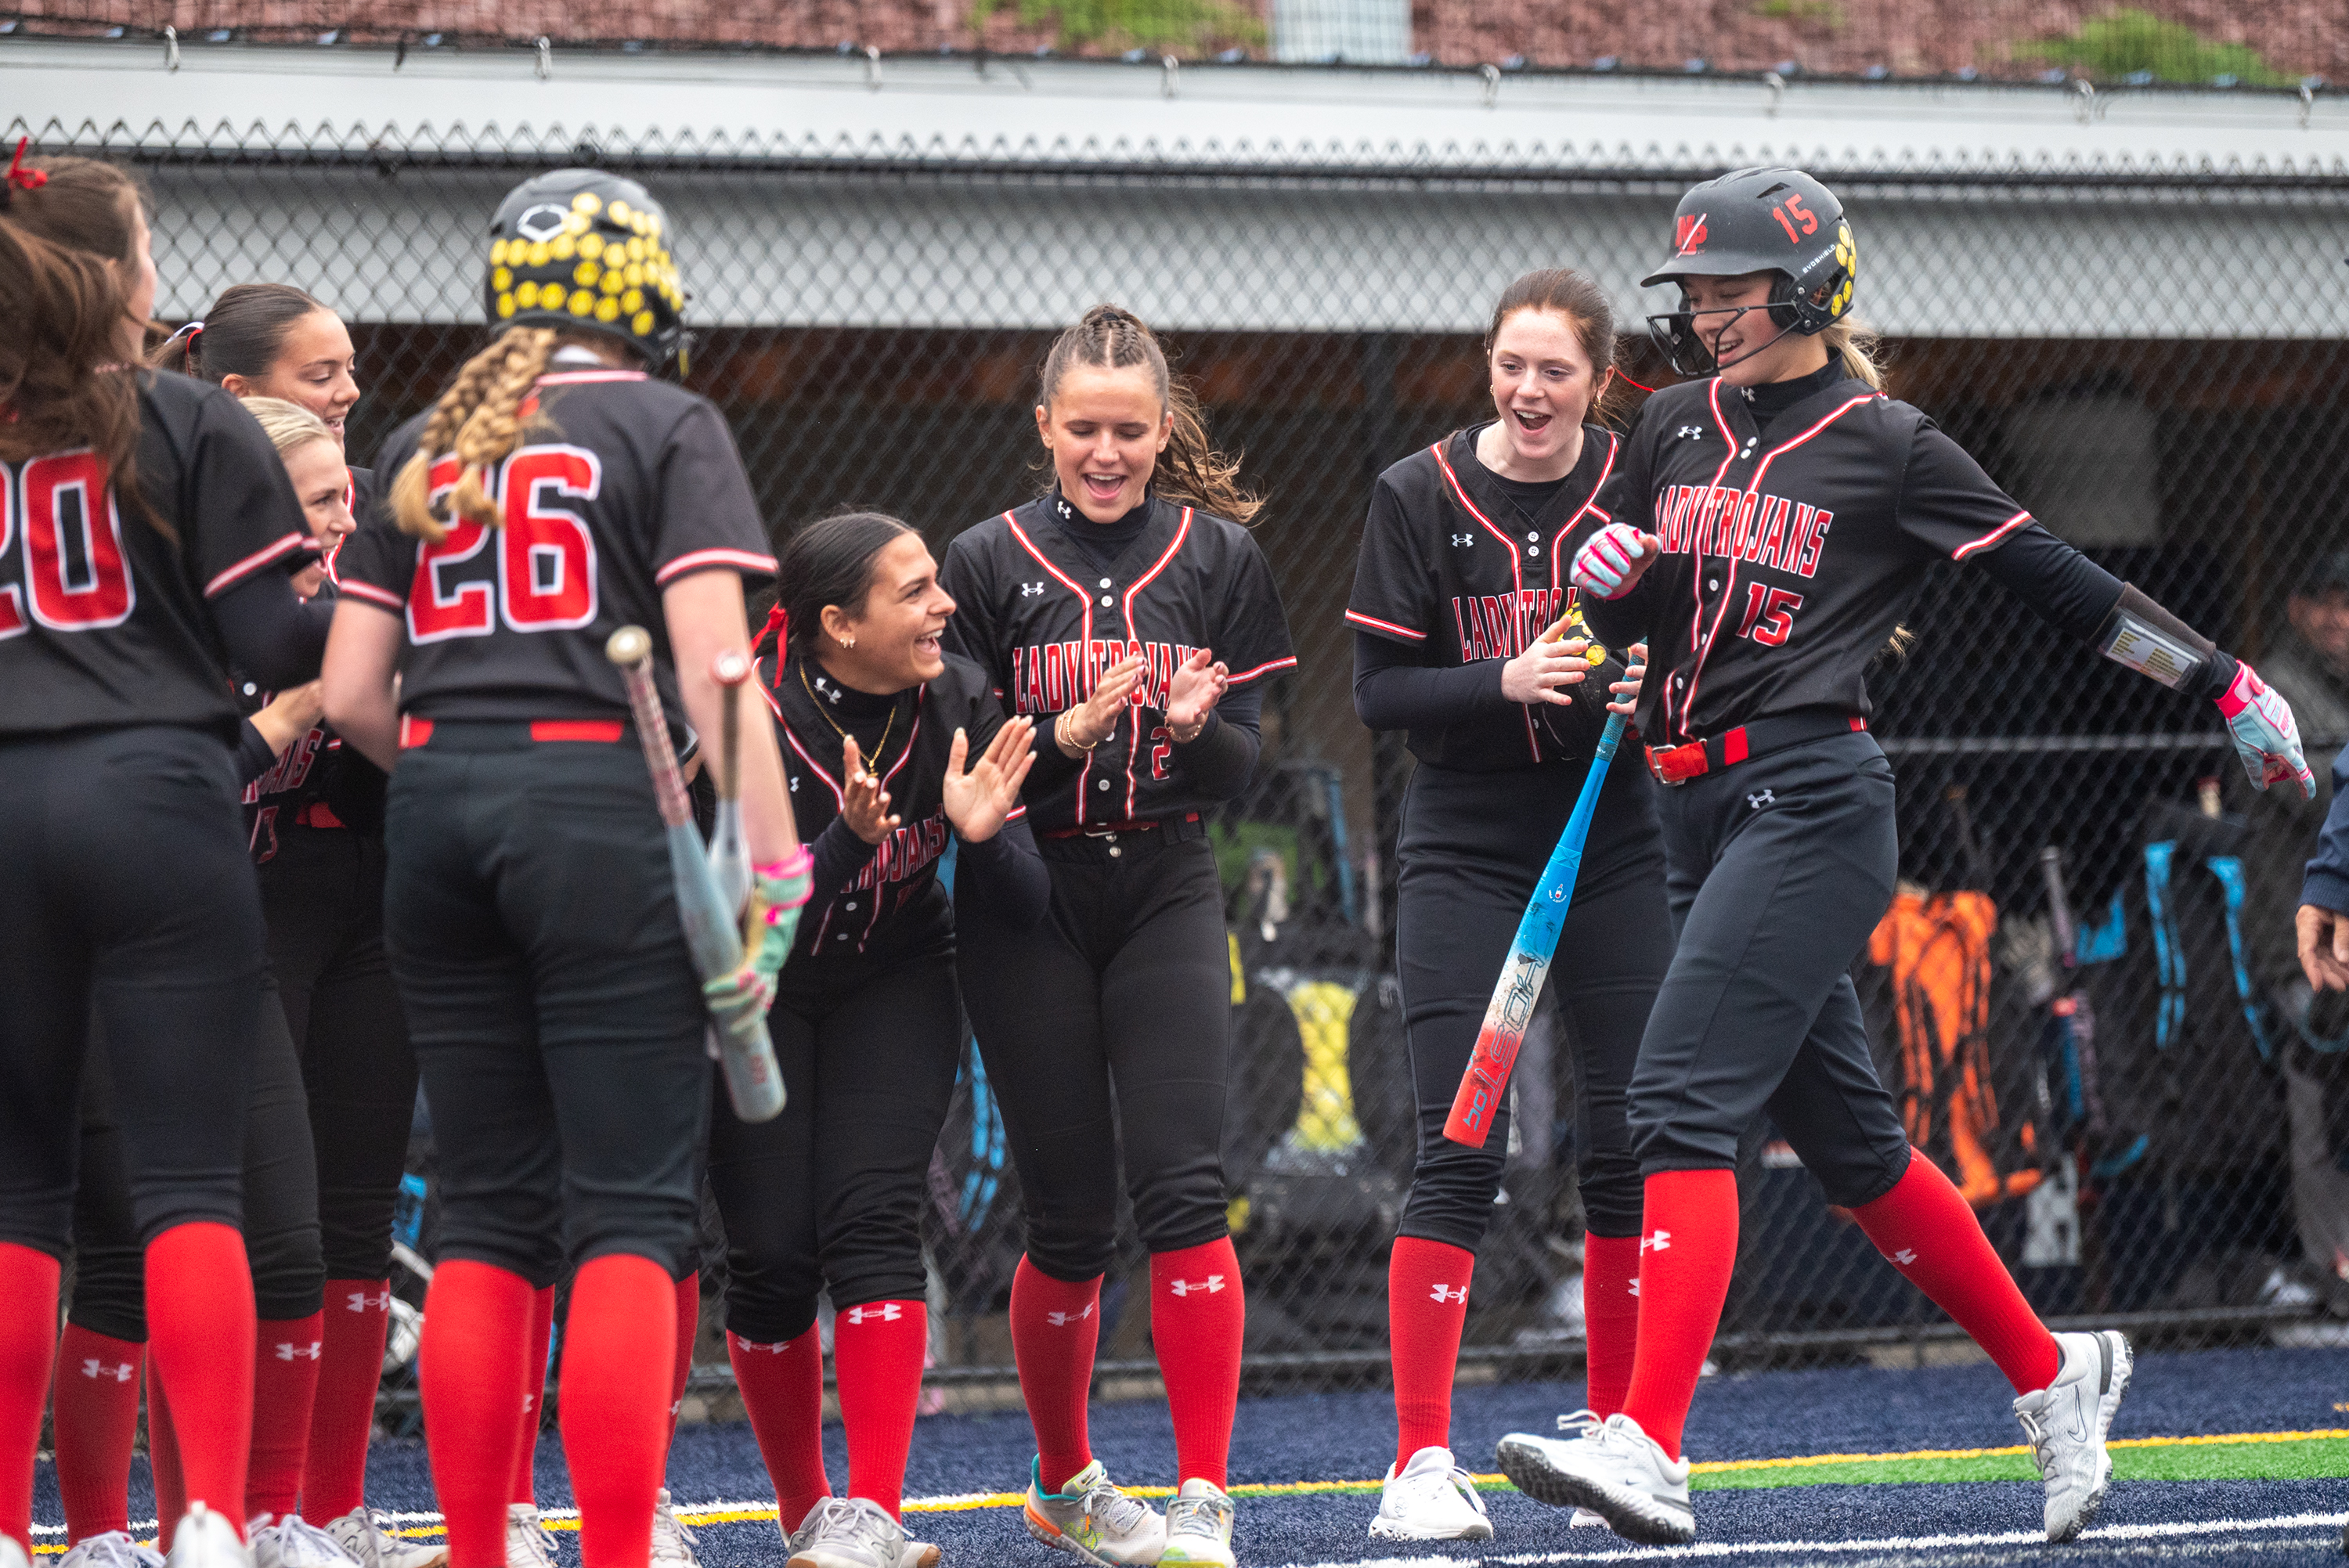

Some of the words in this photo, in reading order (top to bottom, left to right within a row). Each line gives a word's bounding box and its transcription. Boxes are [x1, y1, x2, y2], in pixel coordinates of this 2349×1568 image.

[1773, 193, 1818, 244] 15
[406, 443, 601, 646] 26
[1702, 486, 1835, 579] TROJANS
[1452, 591, 1516, 663] LADY
[1736, 582, 1804, 647] 15
[1012, 640, 1081, 714] LADY
[1150, 726, 1172, 780] 2
